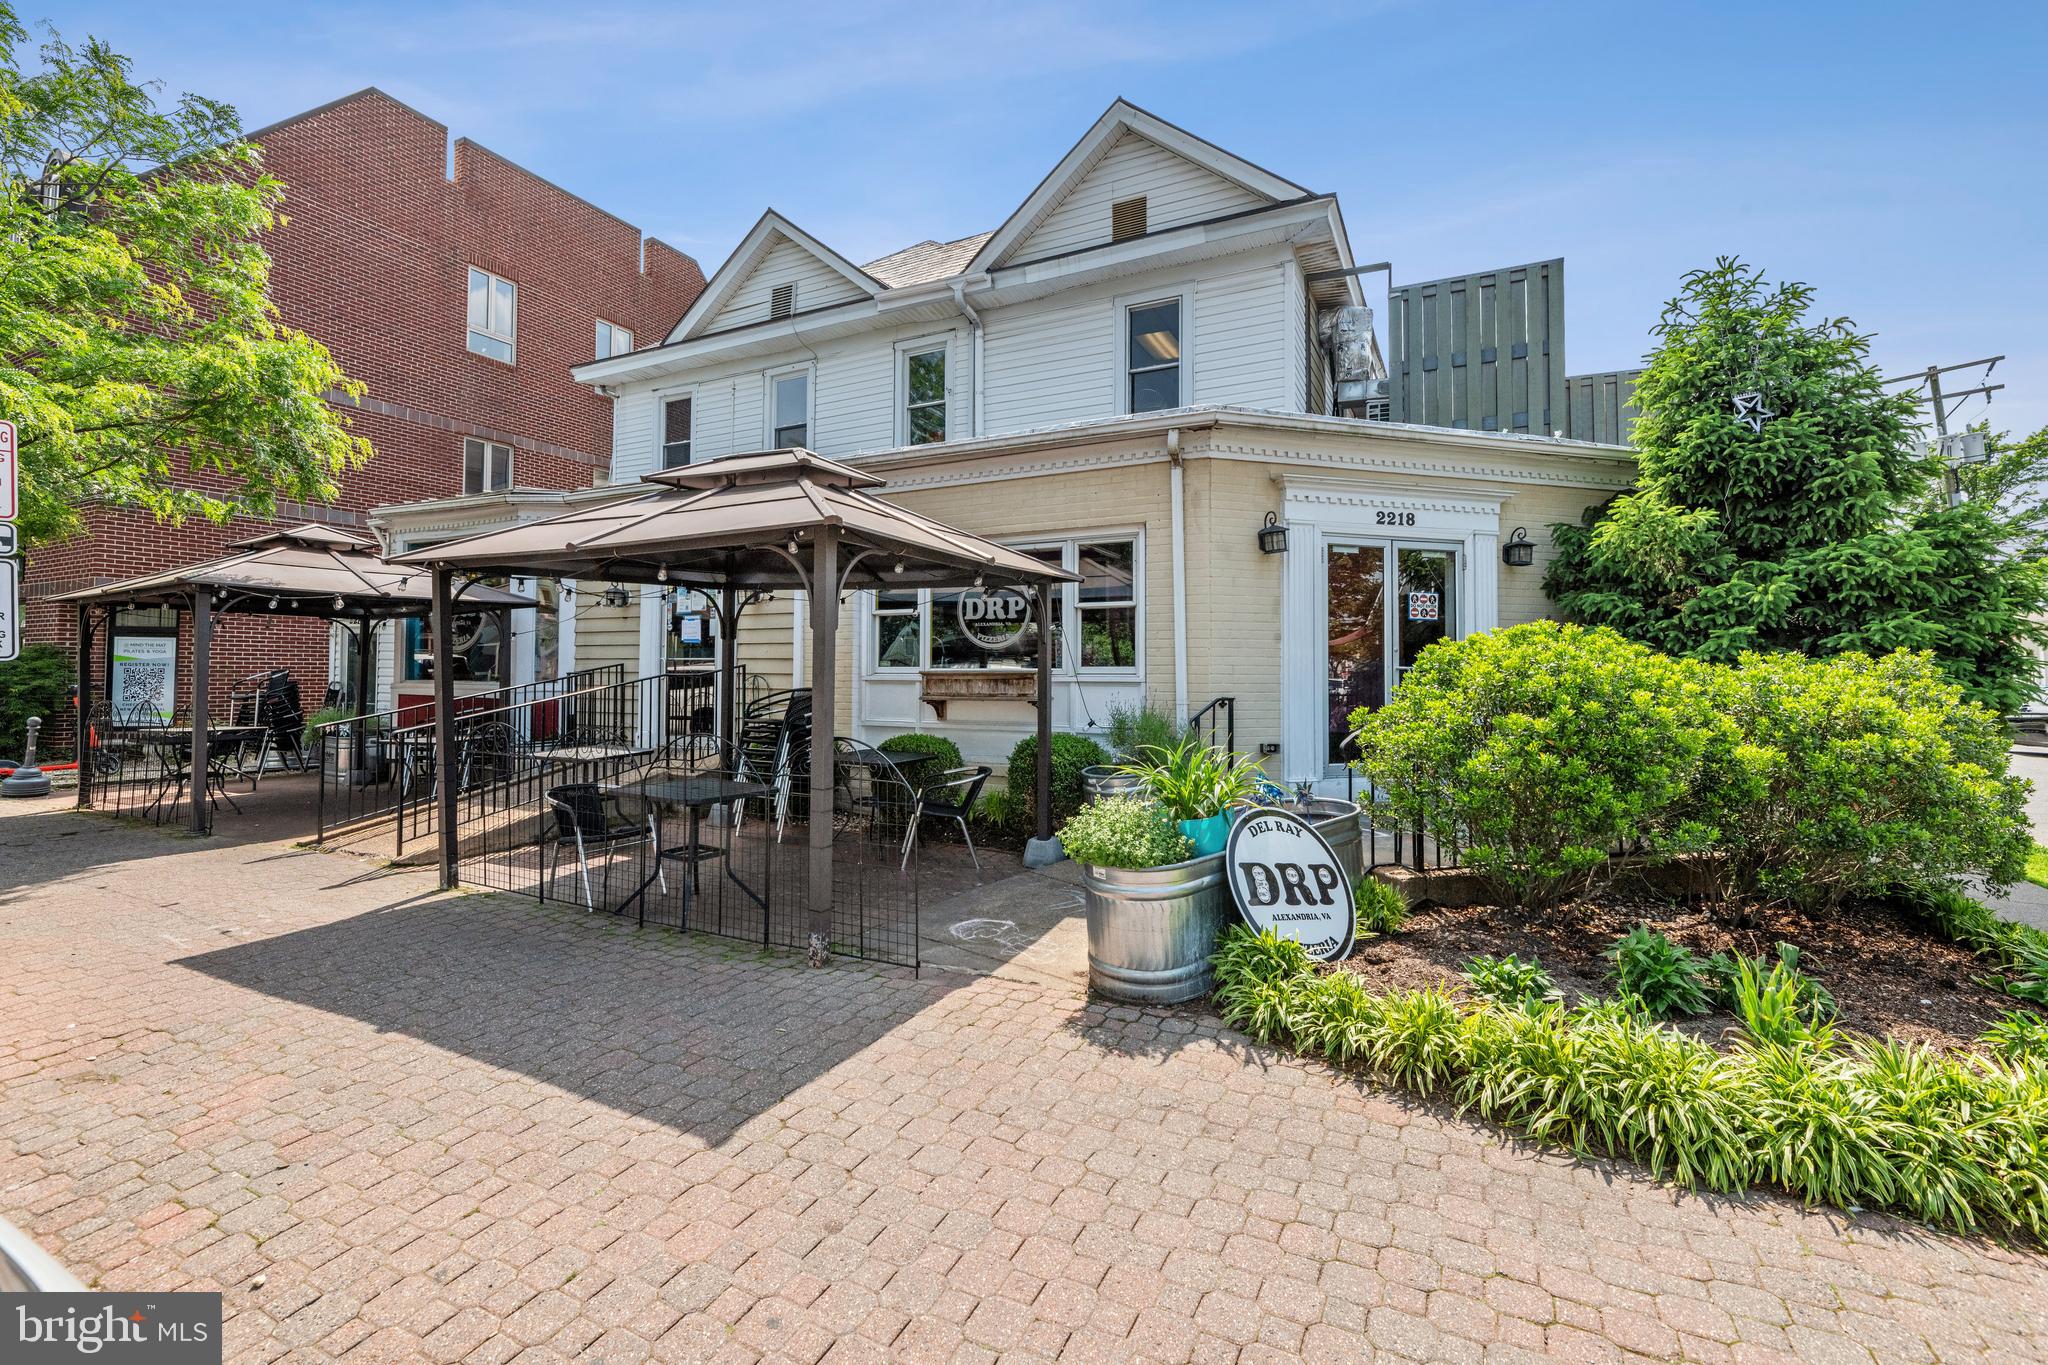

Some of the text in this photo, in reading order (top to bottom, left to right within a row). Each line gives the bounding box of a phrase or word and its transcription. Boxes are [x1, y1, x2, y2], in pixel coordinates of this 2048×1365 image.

[1376, 511, 1415, 526] 2218
[964, 597, 1025, 620] DRP
[977, 633, 1009, 643] PIZZERIA
[1248, 820, 1303, 838] DEL RAY
[1239, 863, 1338, 906] DRP
[1272, 912, 1331, 921] ALEXANDRIA, VA
